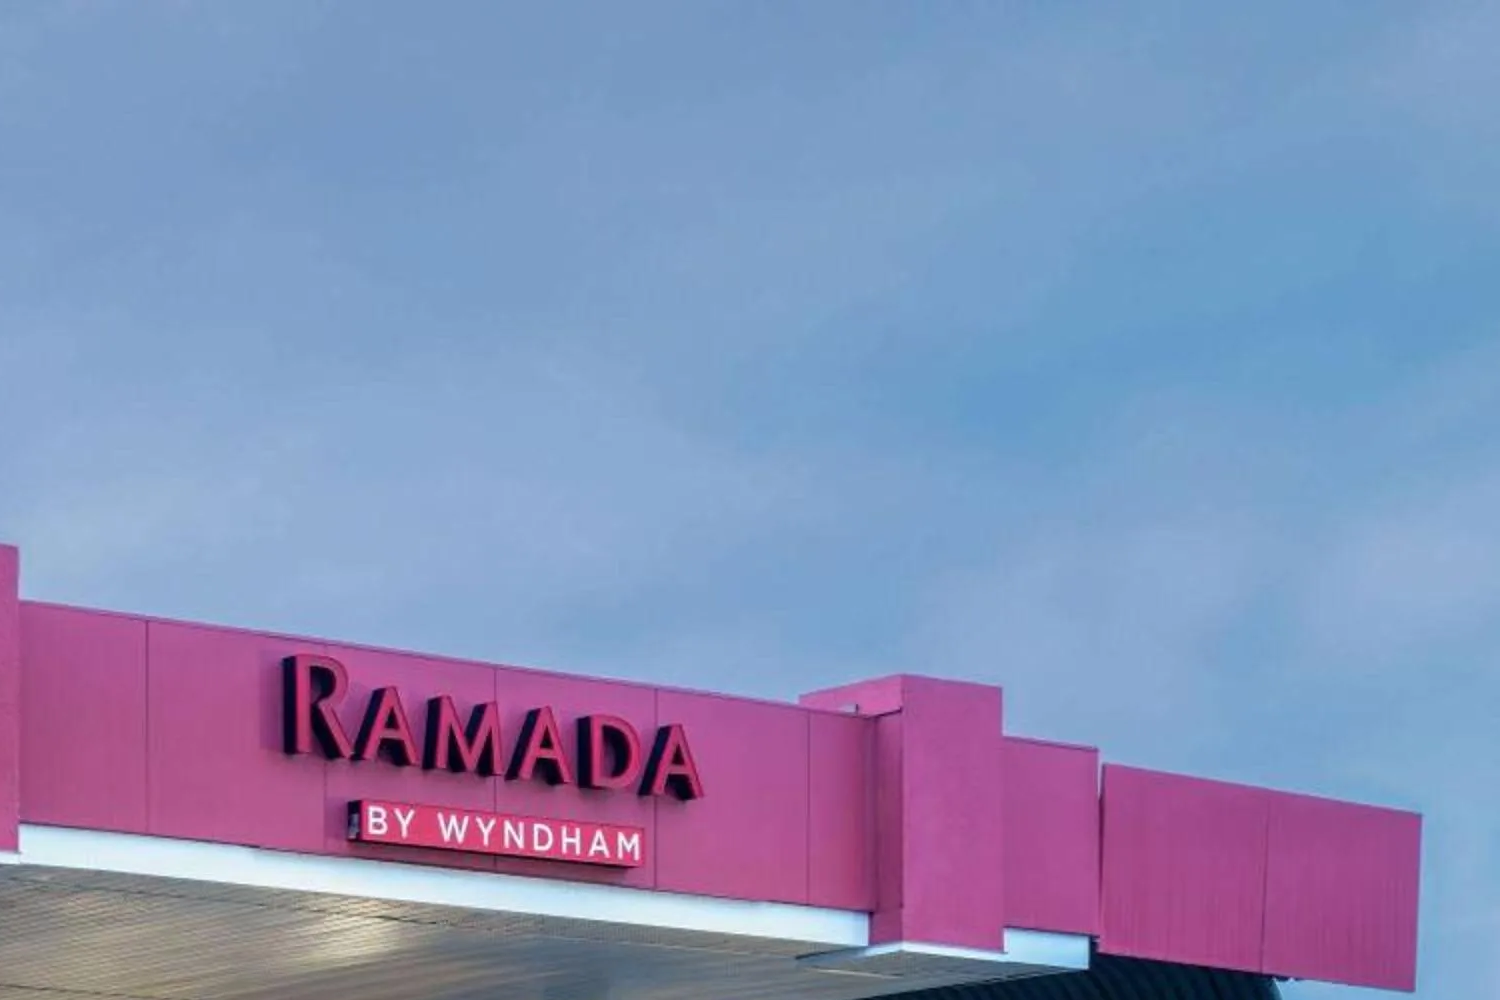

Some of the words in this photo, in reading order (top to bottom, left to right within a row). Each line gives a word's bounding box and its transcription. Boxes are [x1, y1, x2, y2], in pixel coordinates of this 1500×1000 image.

[282, 653, 704, 800] RAMADA
[366, 806, 414, 837] BY
[438, 812, 641, 861] WYNDHAM
